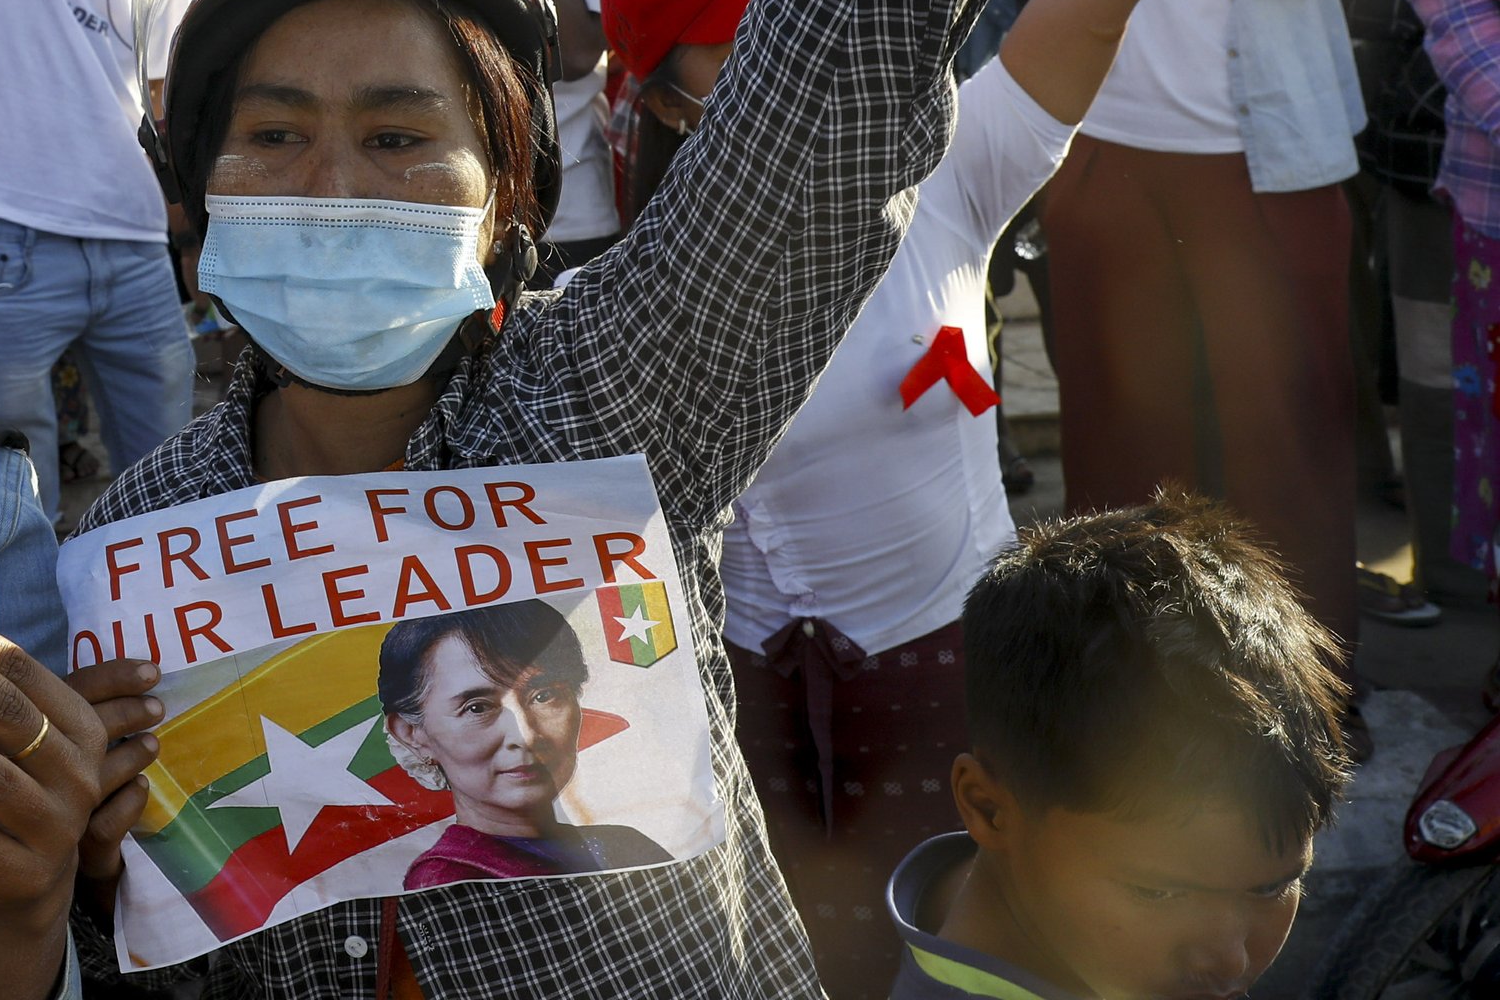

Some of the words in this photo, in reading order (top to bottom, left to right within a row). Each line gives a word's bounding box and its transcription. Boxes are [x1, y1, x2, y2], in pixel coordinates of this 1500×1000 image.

[72, 600, 235, 673] OUR
[260, 530, 658, 639] LEADER
[104, 494, 335, 602] FREE
[364, 480, 547, 543] FOR
